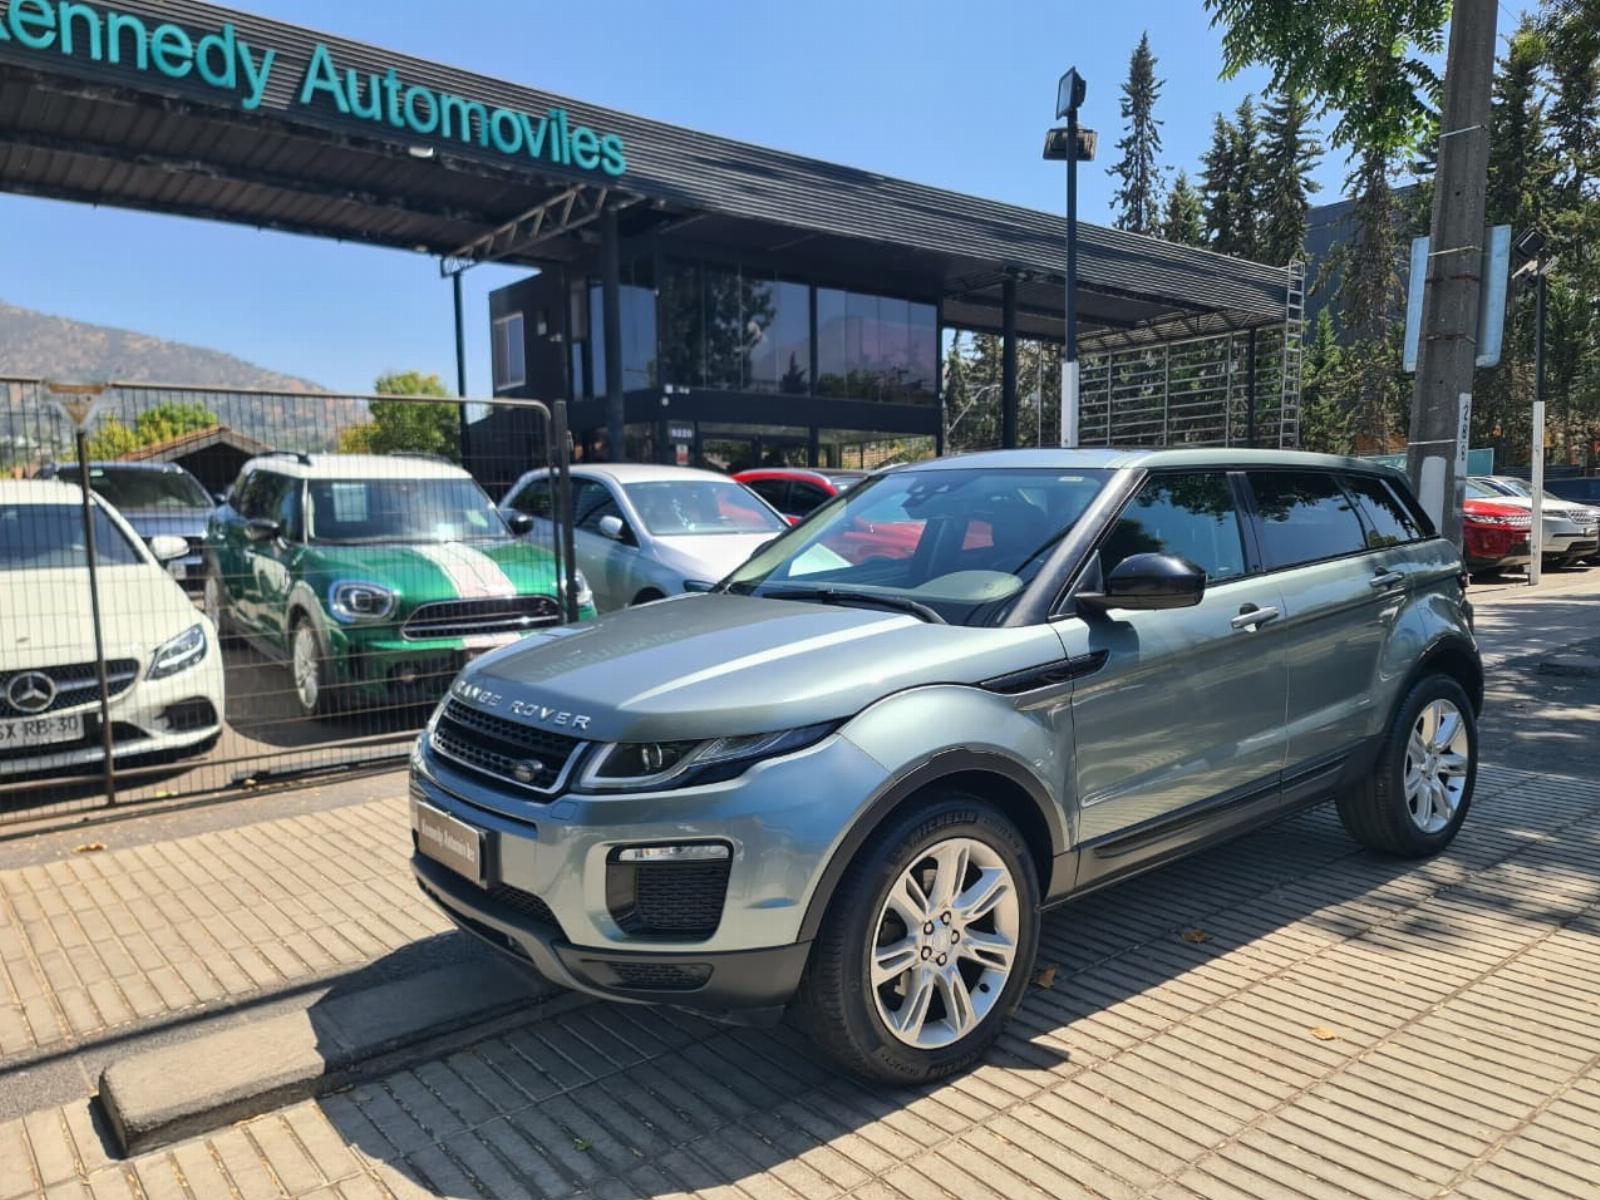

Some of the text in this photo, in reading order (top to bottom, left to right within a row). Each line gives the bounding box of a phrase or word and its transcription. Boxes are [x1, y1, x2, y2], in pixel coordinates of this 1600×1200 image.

[0, 0, 628, 177] ennedy Automoviles
[511, 700, 591, 729] ROVER
